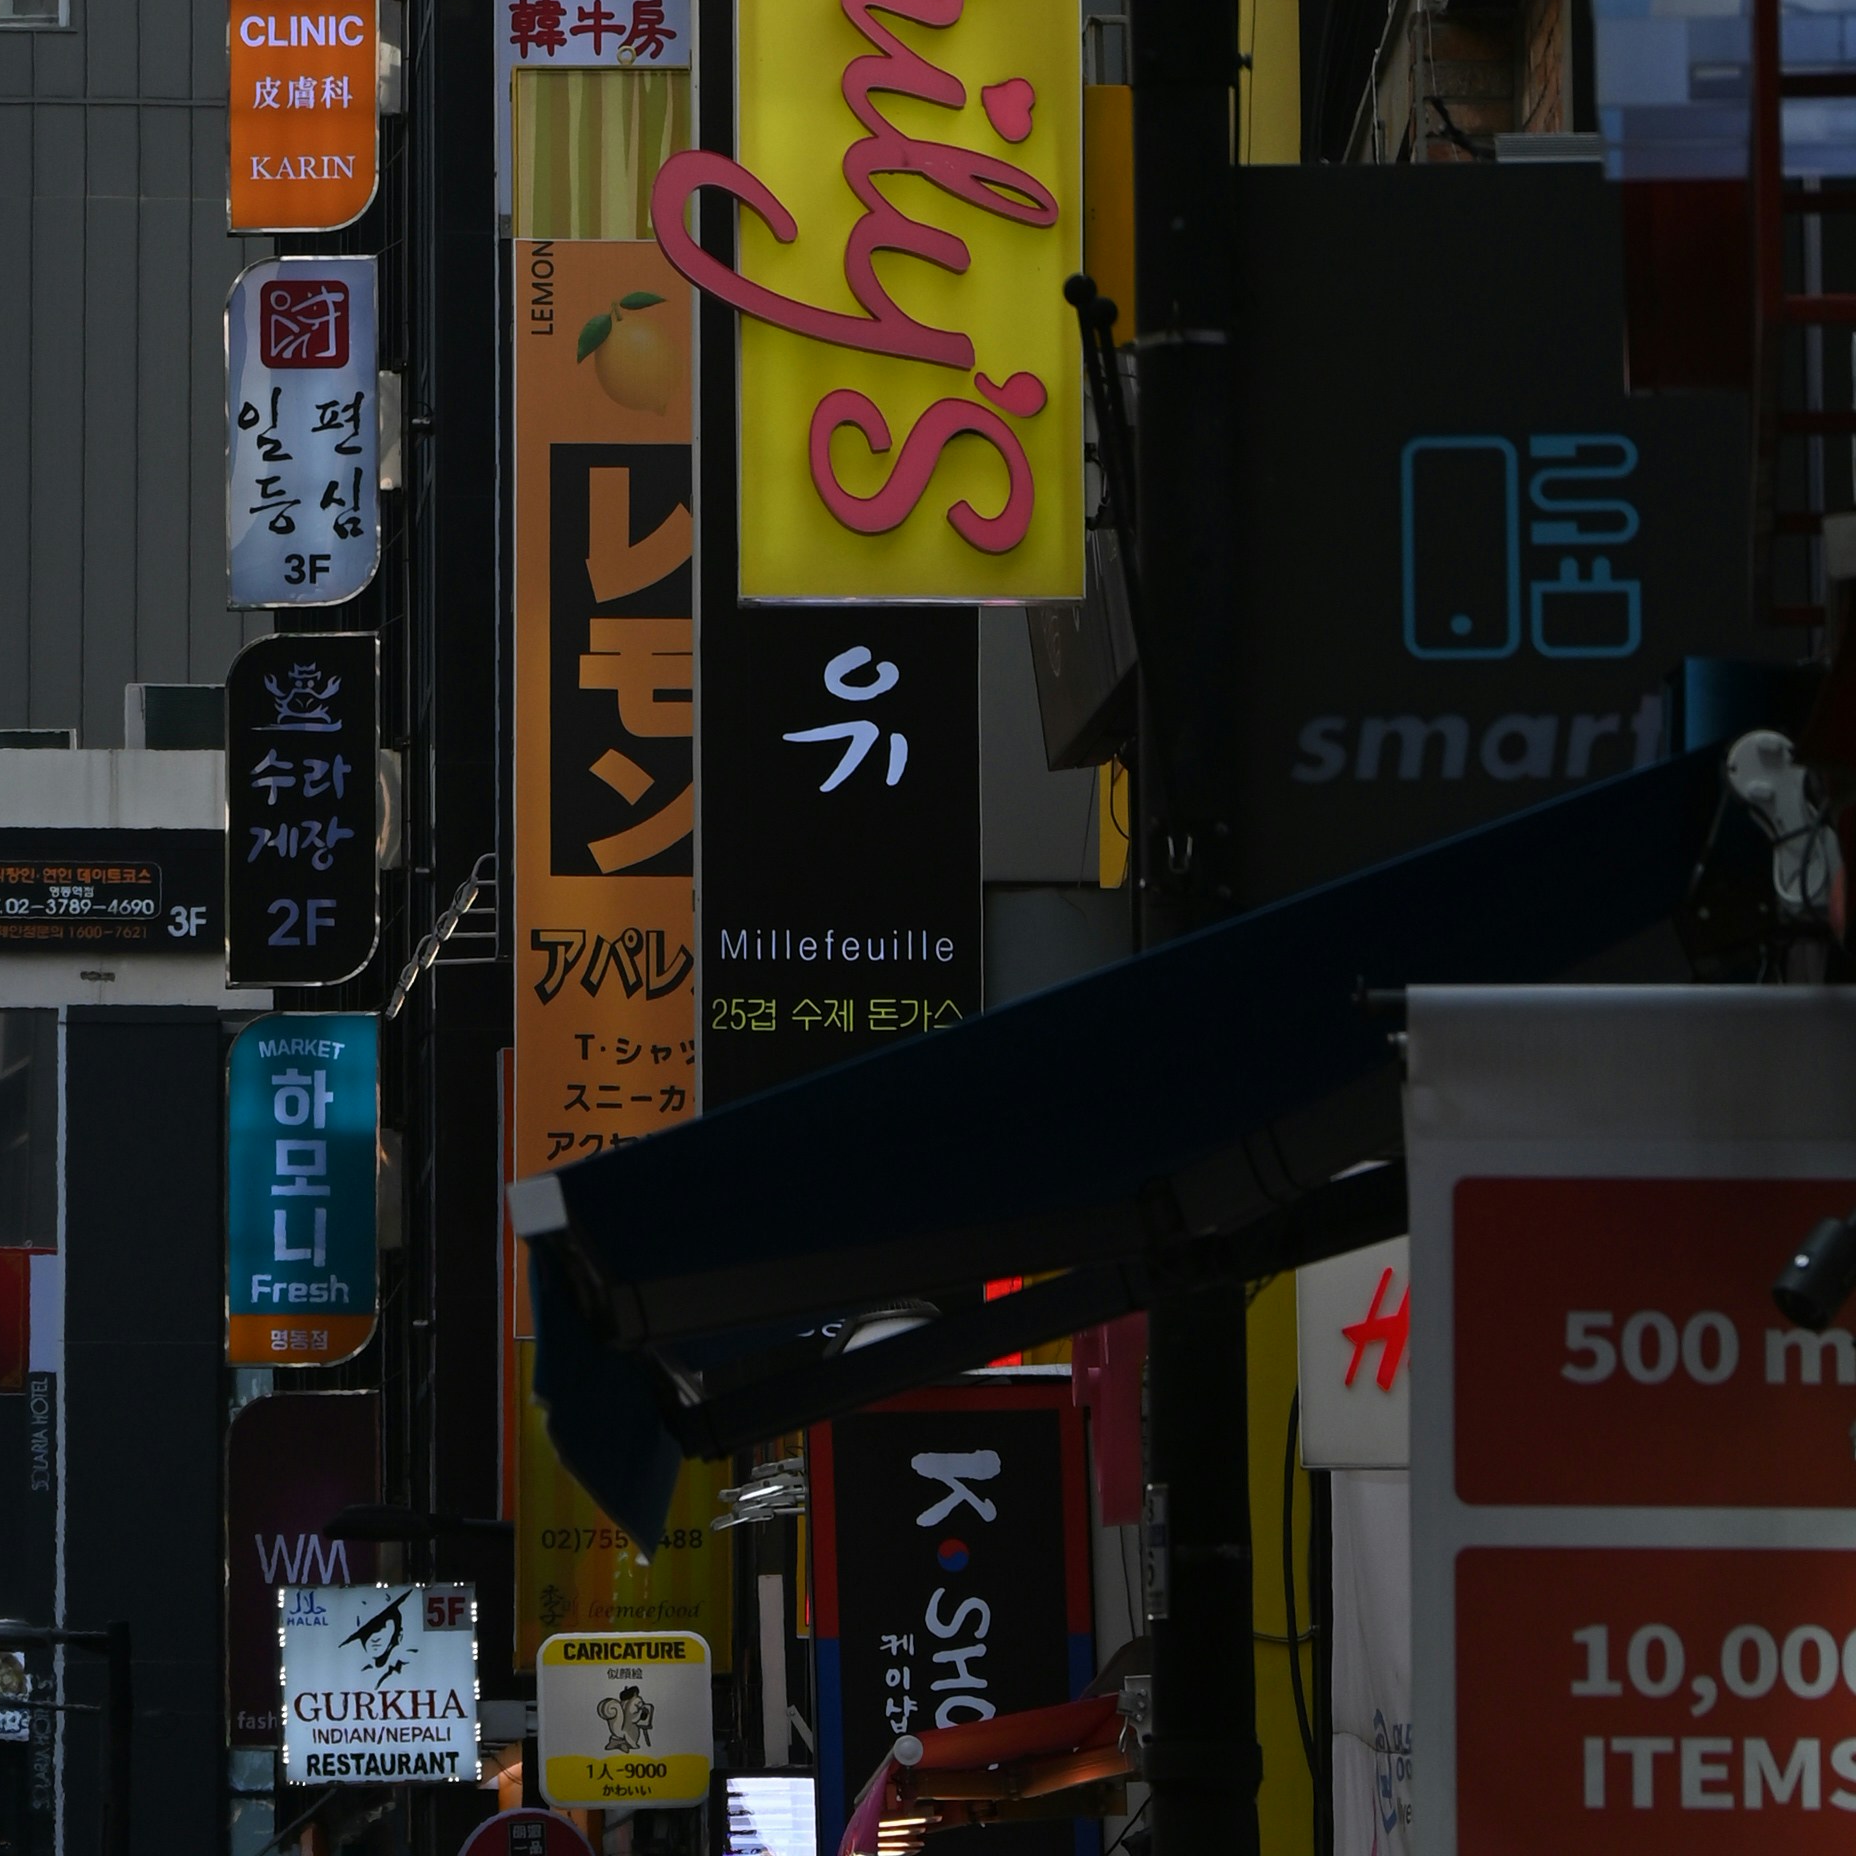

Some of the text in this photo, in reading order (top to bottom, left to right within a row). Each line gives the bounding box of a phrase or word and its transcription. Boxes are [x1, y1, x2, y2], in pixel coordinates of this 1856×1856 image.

[240, 15, 364, 48] CLINIC
[253, 76, 353, 110] 皮膚科
[250, 155, 356, 181] KARIN
[531, 240, 555, 336] LEMON
[284, 553, 331, 585] 3F
[250, 748, 352, 806] 수라
[247, 816, 355, 871] 게장
[68, 925, 148, 939] 1600-7621
[167, 906, 207, 938] 3F
[266, 898, 337, 946] 2F
[720, 929, 954, 962] Millefeuille
[712, 998, 964, 1033] 25겹 수제 돈가스
[258, 1038, 345, 1061] MARKET
[270, 1068, 334, 1268] 하모니
[250, 1273, 350, 1304] Fresh
[1562, 1311, 1740, 1386] 500
[287, 1616, 329, 1626] HALAL
[426, 1596, 465, 1626] 5F
[563, 1641, 686, 1661] CARICATURE
[879, 1633, 919, 1734] 케이샵
[293, 1688, 468, 1723] GURKHA
[312, 1726, 452, 1743] INDIAN/NEPALI
[306, 1752, 459, 1777] RESTAURANT
[602, 1784, 652, 1796] かわいい
